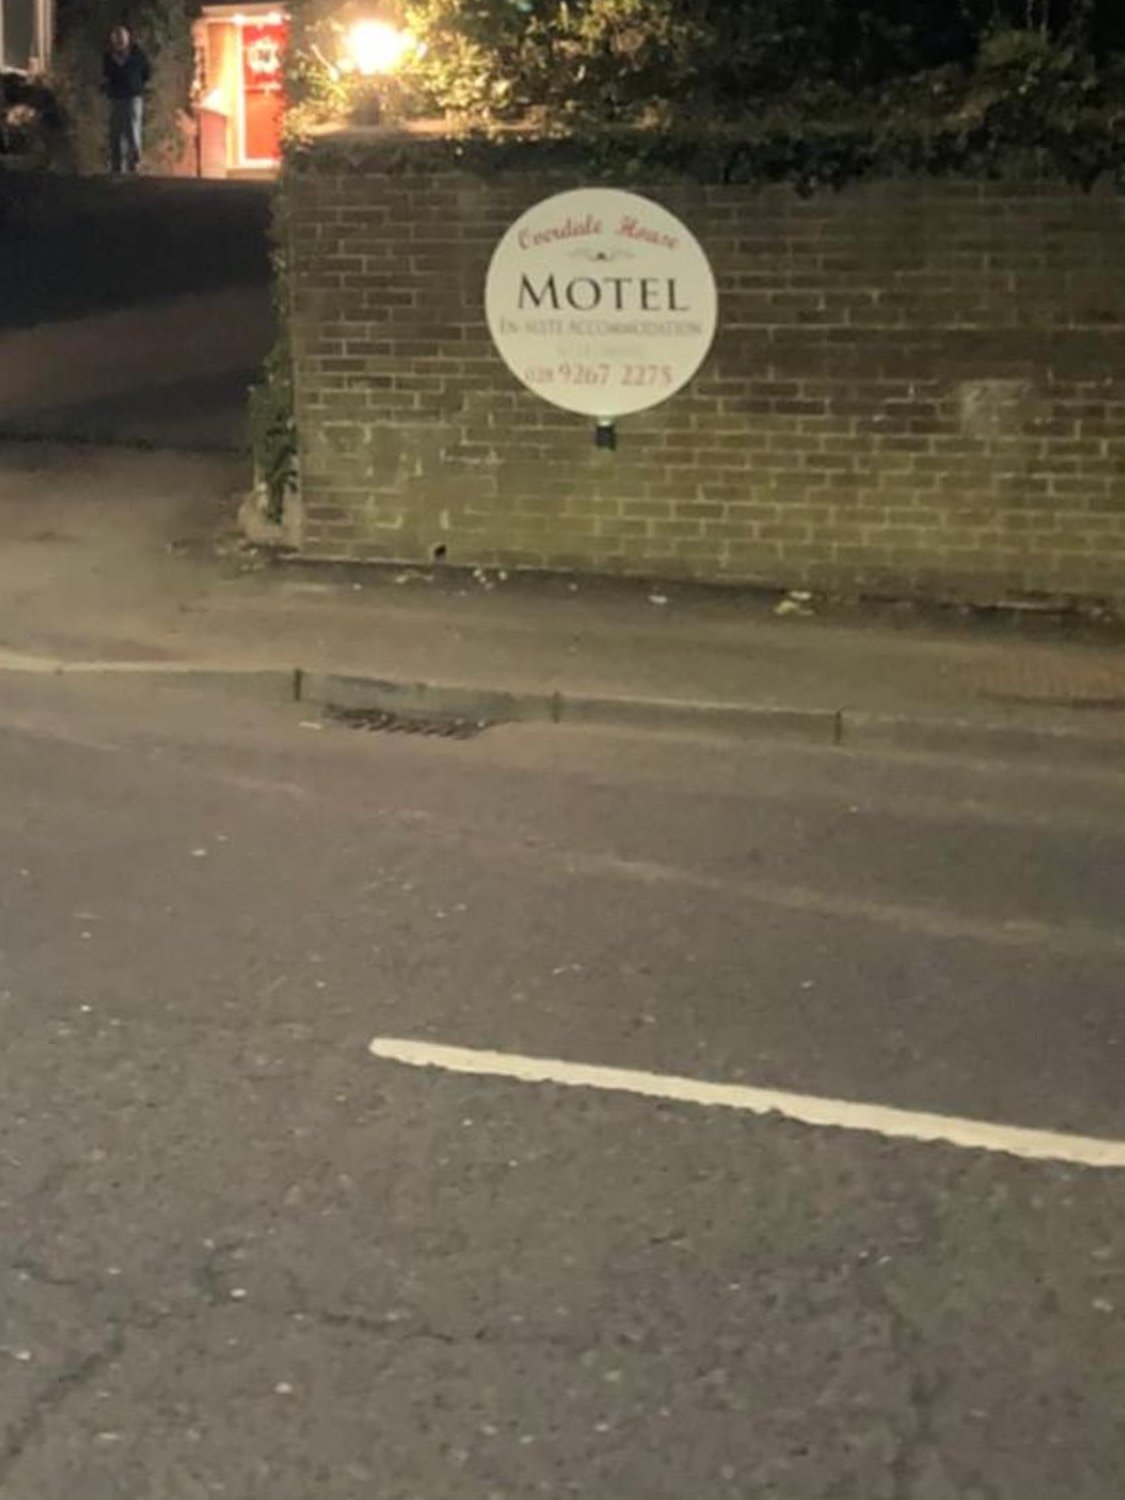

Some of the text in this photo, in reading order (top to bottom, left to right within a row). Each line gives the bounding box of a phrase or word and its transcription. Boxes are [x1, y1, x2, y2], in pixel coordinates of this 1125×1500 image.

[615, 215, 679, 251] House
[518, 273, 690, 311] MOTEL
[558, 363, 610, 386] 9267
